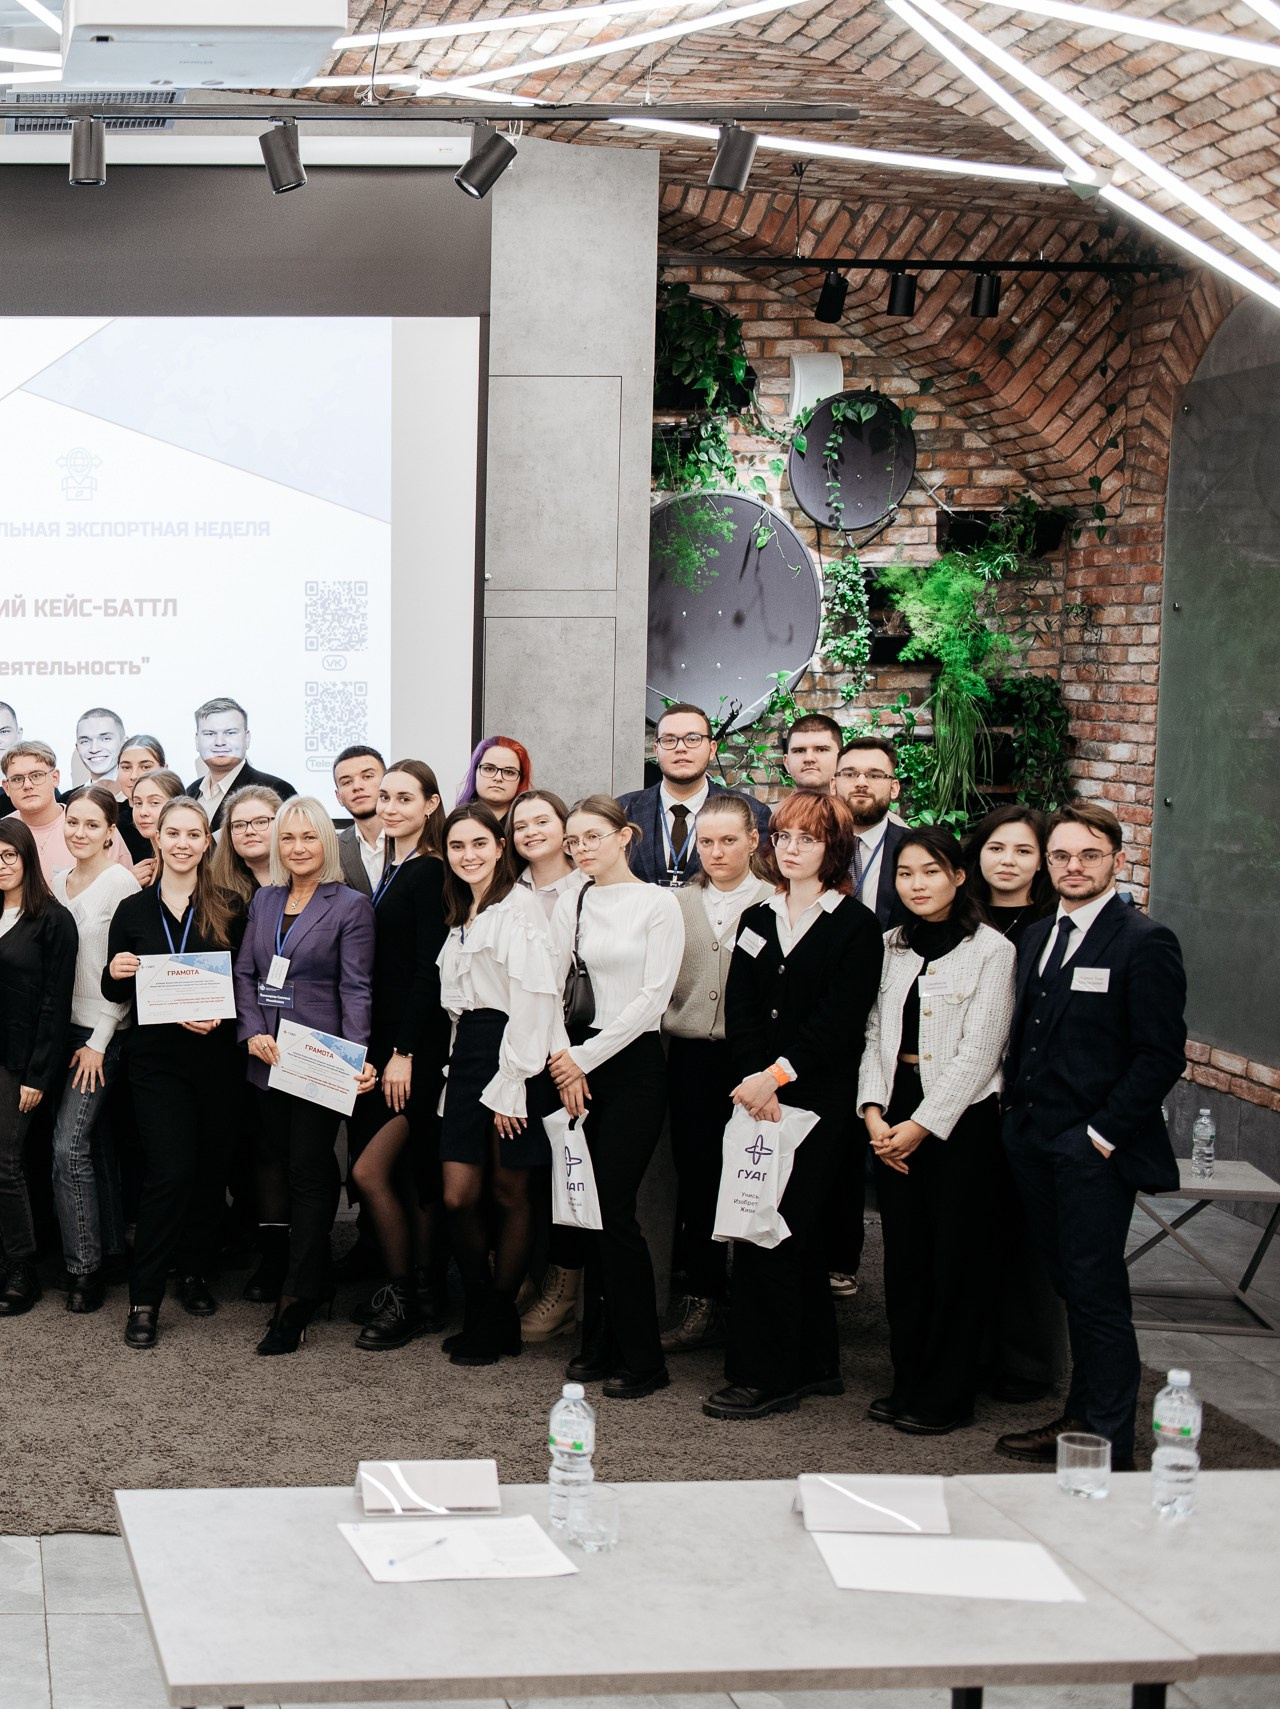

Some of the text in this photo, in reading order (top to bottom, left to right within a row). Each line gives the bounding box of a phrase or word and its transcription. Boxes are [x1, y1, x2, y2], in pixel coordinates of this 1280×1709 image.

[65, 521, 190, 538] ЭКСПОРТНАЯ
[194, 521, 271, 539] НЕДЕЛЯ
[34, 594, 178, 618] КЕЙС-БАТТЛ
[325, 658, 343, 668] VK
[304, 1044, 334, 1059] ГРАМОТА
[733, 1198, 758, 1207] Изобрет
